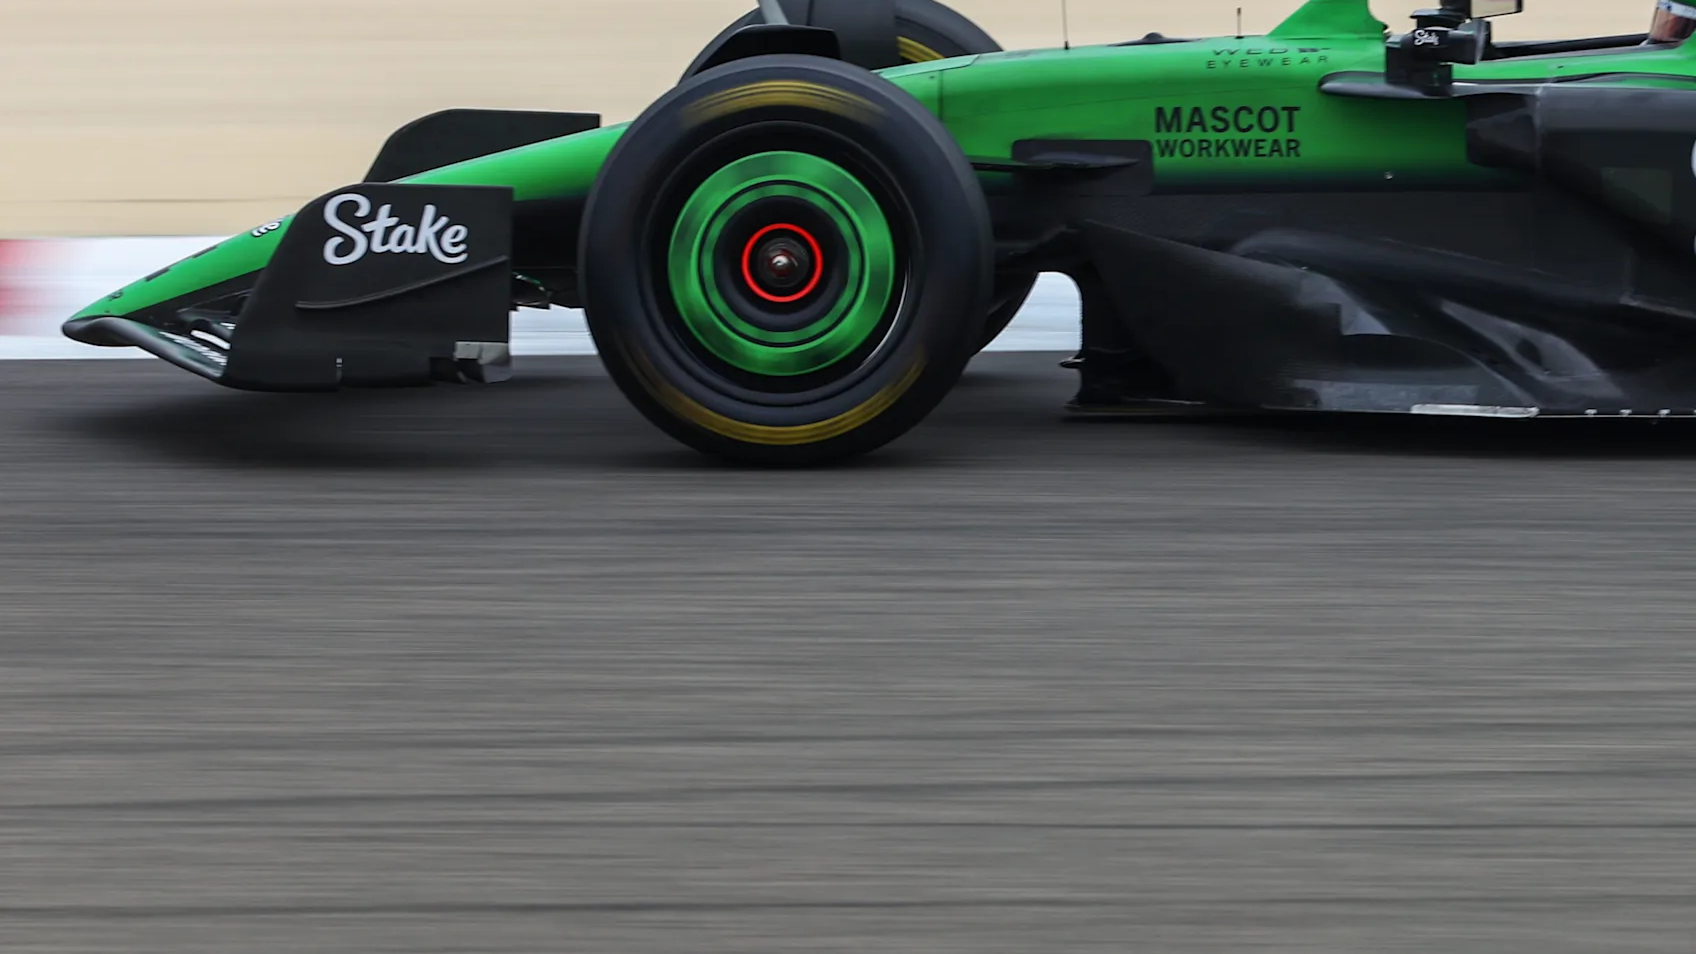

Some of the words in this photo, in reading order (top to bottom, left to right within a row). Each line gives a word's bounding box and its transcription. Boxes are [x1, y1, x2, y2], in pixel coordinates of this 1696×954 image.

[1206, 55, 1329, 69] EYEWEAR
[1155, 106, 1301, 133] MASCOT
[1156, 139, 1301, 158] WORKWEAR
[322, 193, 469, 266] Stake
